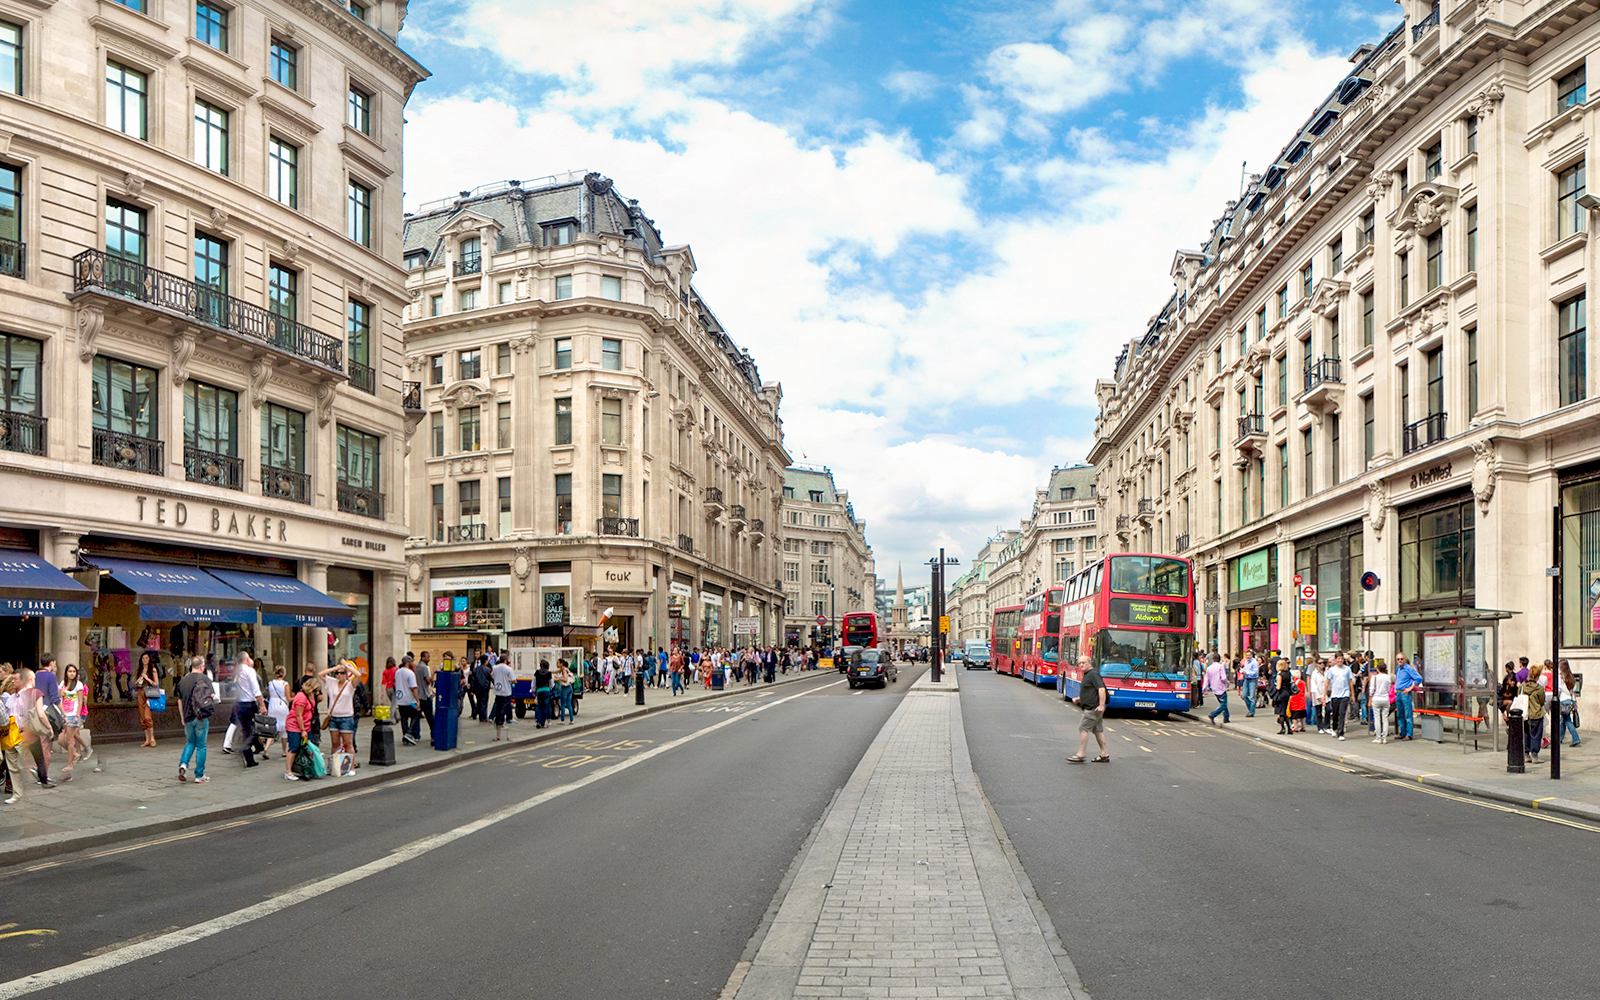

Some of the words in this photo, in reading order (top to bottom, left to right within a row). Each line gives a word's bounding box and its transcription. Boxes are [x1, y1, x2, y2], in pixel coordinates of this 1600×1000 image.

[1418, 462, 1452, 487] NatWest
[137, 495, 187, 526] TED
[211, 507, 287, 542] BAKER
[342, 537, 362, 547] KAREN
[365, 541, 386, 551] MILLEN
[1242, 561, 1263, 581] Morgan
[159, 573, 198, 581] BAKER
[605, 571, 631, 581] fcuk
[29, 601, 55, 609] BAKER
[436, 600, 449, 608] £49
[546, 605, 563, 613] SALE
[1162, 605, 1168, 614] 6
[437, 614, 449, 623] £10
[1135, 613, 1163, 622] Aldwych
